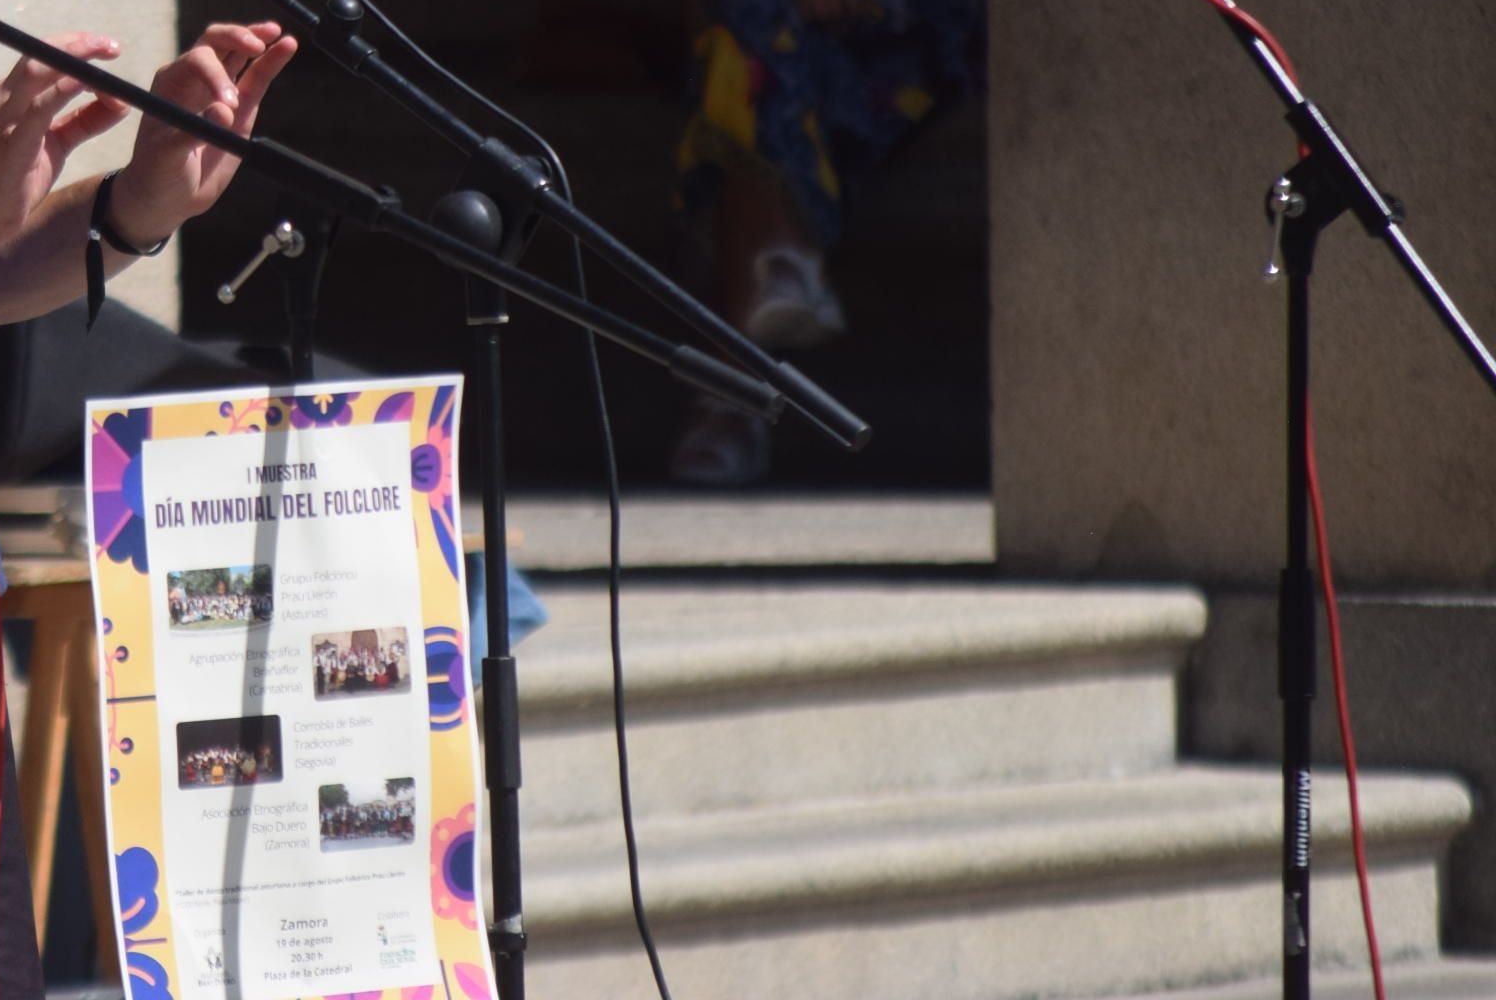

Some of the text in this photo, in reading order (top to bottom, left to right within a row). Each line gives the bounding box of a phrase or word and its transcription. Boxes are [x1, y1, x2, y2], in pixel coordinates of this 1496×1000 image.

[247, 463, 318, 484] I MUESTRA
[155, 485, 401, 528] DÍA MUNDIAL DEL FOLCLORE
[1296, 770, 1310, 867] Millenium
[252, 820, 308, 835] Bajo Duero
[265, 838, 310, 851] (Zamora)
[280, 917, 328, 931] Zamora
[276, 935, 334, 949] 19 de agosto
[317, 951, 324, 960] h
[264, 964, 353, 982] Plaza de la Catedral
